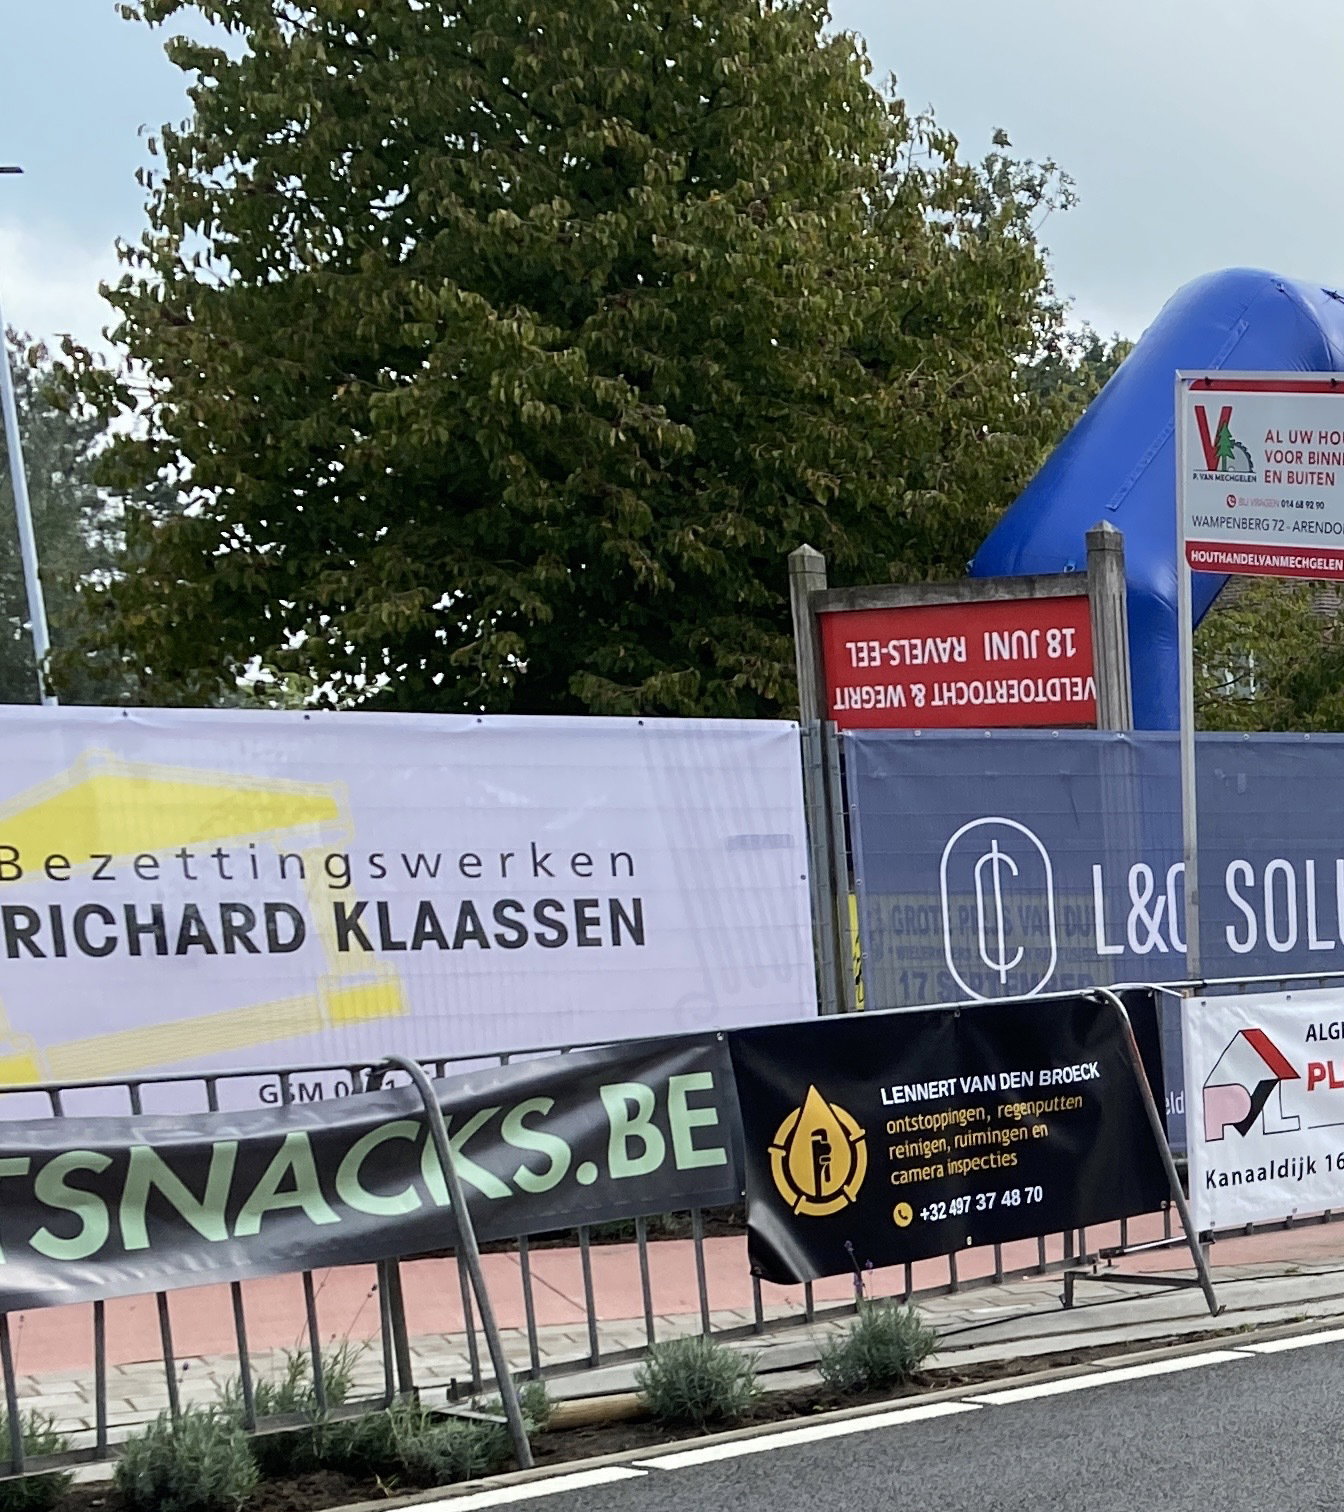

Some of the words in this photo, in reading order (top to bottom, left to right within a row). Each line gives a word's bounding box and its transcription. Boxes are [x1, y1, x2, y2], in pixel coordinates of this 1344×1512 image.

[1264, 429, 1283, 444] AL
[1289, 430, 1313, 445] UW
[1264, 450, 1304, 465] VOOR
[1264, 470, 1282, 484] EN
[1287, 471, 1335, 486] BUITEN
[1192, 515, 1270, 531] WAMPENBERG
[1272, 519, 1285, 532] 72
[845, 636, 967, 668] RAVELS-EEL
[984, 629, 1041, 661] JUNI
[1046, 628, 1077, 658] 18
[833, 684, 906, 710] WEGRIT
[910, 683, 926, 707] &
[931, 676, 1097, 706] VELDTOERTOCHT
[0, 842, 635, 889] Bezettingswerken
[1, 902, 307, 958] RICHARD
[333, 898, 646, 953] KLAASSEN
[880, 1078, 957, 1106] LENNERT
[959, 1073, 997, 1094] VAN
[999, 1070, 1034, 1091] DEN
[1038, 1061, 1101, 1087] BROECK
[886, 1106, 991, 1135] ontstoppingen,
[998, 1094, 1084, 1121] regenputten
[889, 1138, 951, 1160] reinigen,
[954, 1127, 1028, 1149] ruimingen
[1032, 1122, 1049, 1138] en
[890, 1163, 945, 1186] camera
[947, 1150, 1018, 1175] inspecties
[1205, 1155, 1318, 1190] Kanaaldijk
[919, 1201, 947, 1222] +32
[949, 1196, 971, 1217] 497
[975, 1192, 996, 1211] 37
[1001, 1188, 1021, 1208] 48
[1024, 1185, 1043, 1203] 70
